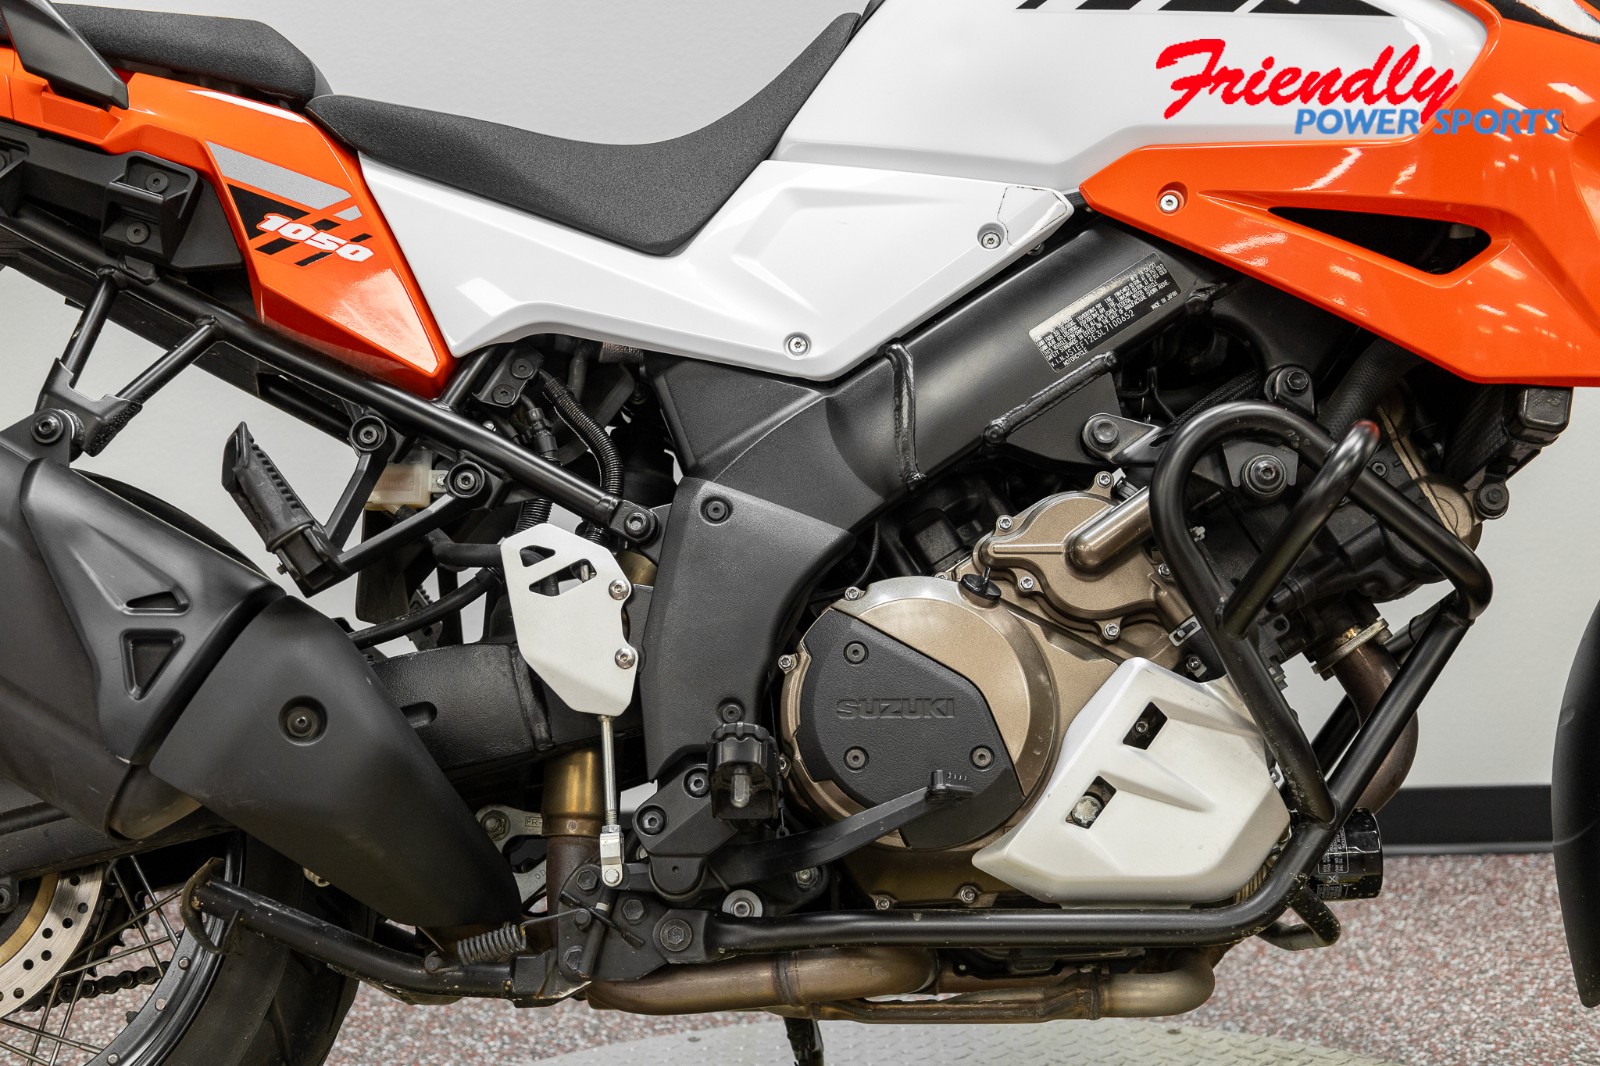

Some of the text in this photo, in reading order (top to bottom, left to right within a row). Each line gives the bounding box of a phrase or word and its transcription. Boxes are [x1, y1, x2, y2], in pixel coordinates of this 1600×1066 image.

[259, 214, 375, 262] 1050
[1063, 347, 1088, 366] MOTORCYCLE
[836, 698, 955, 719] SUZUKI
